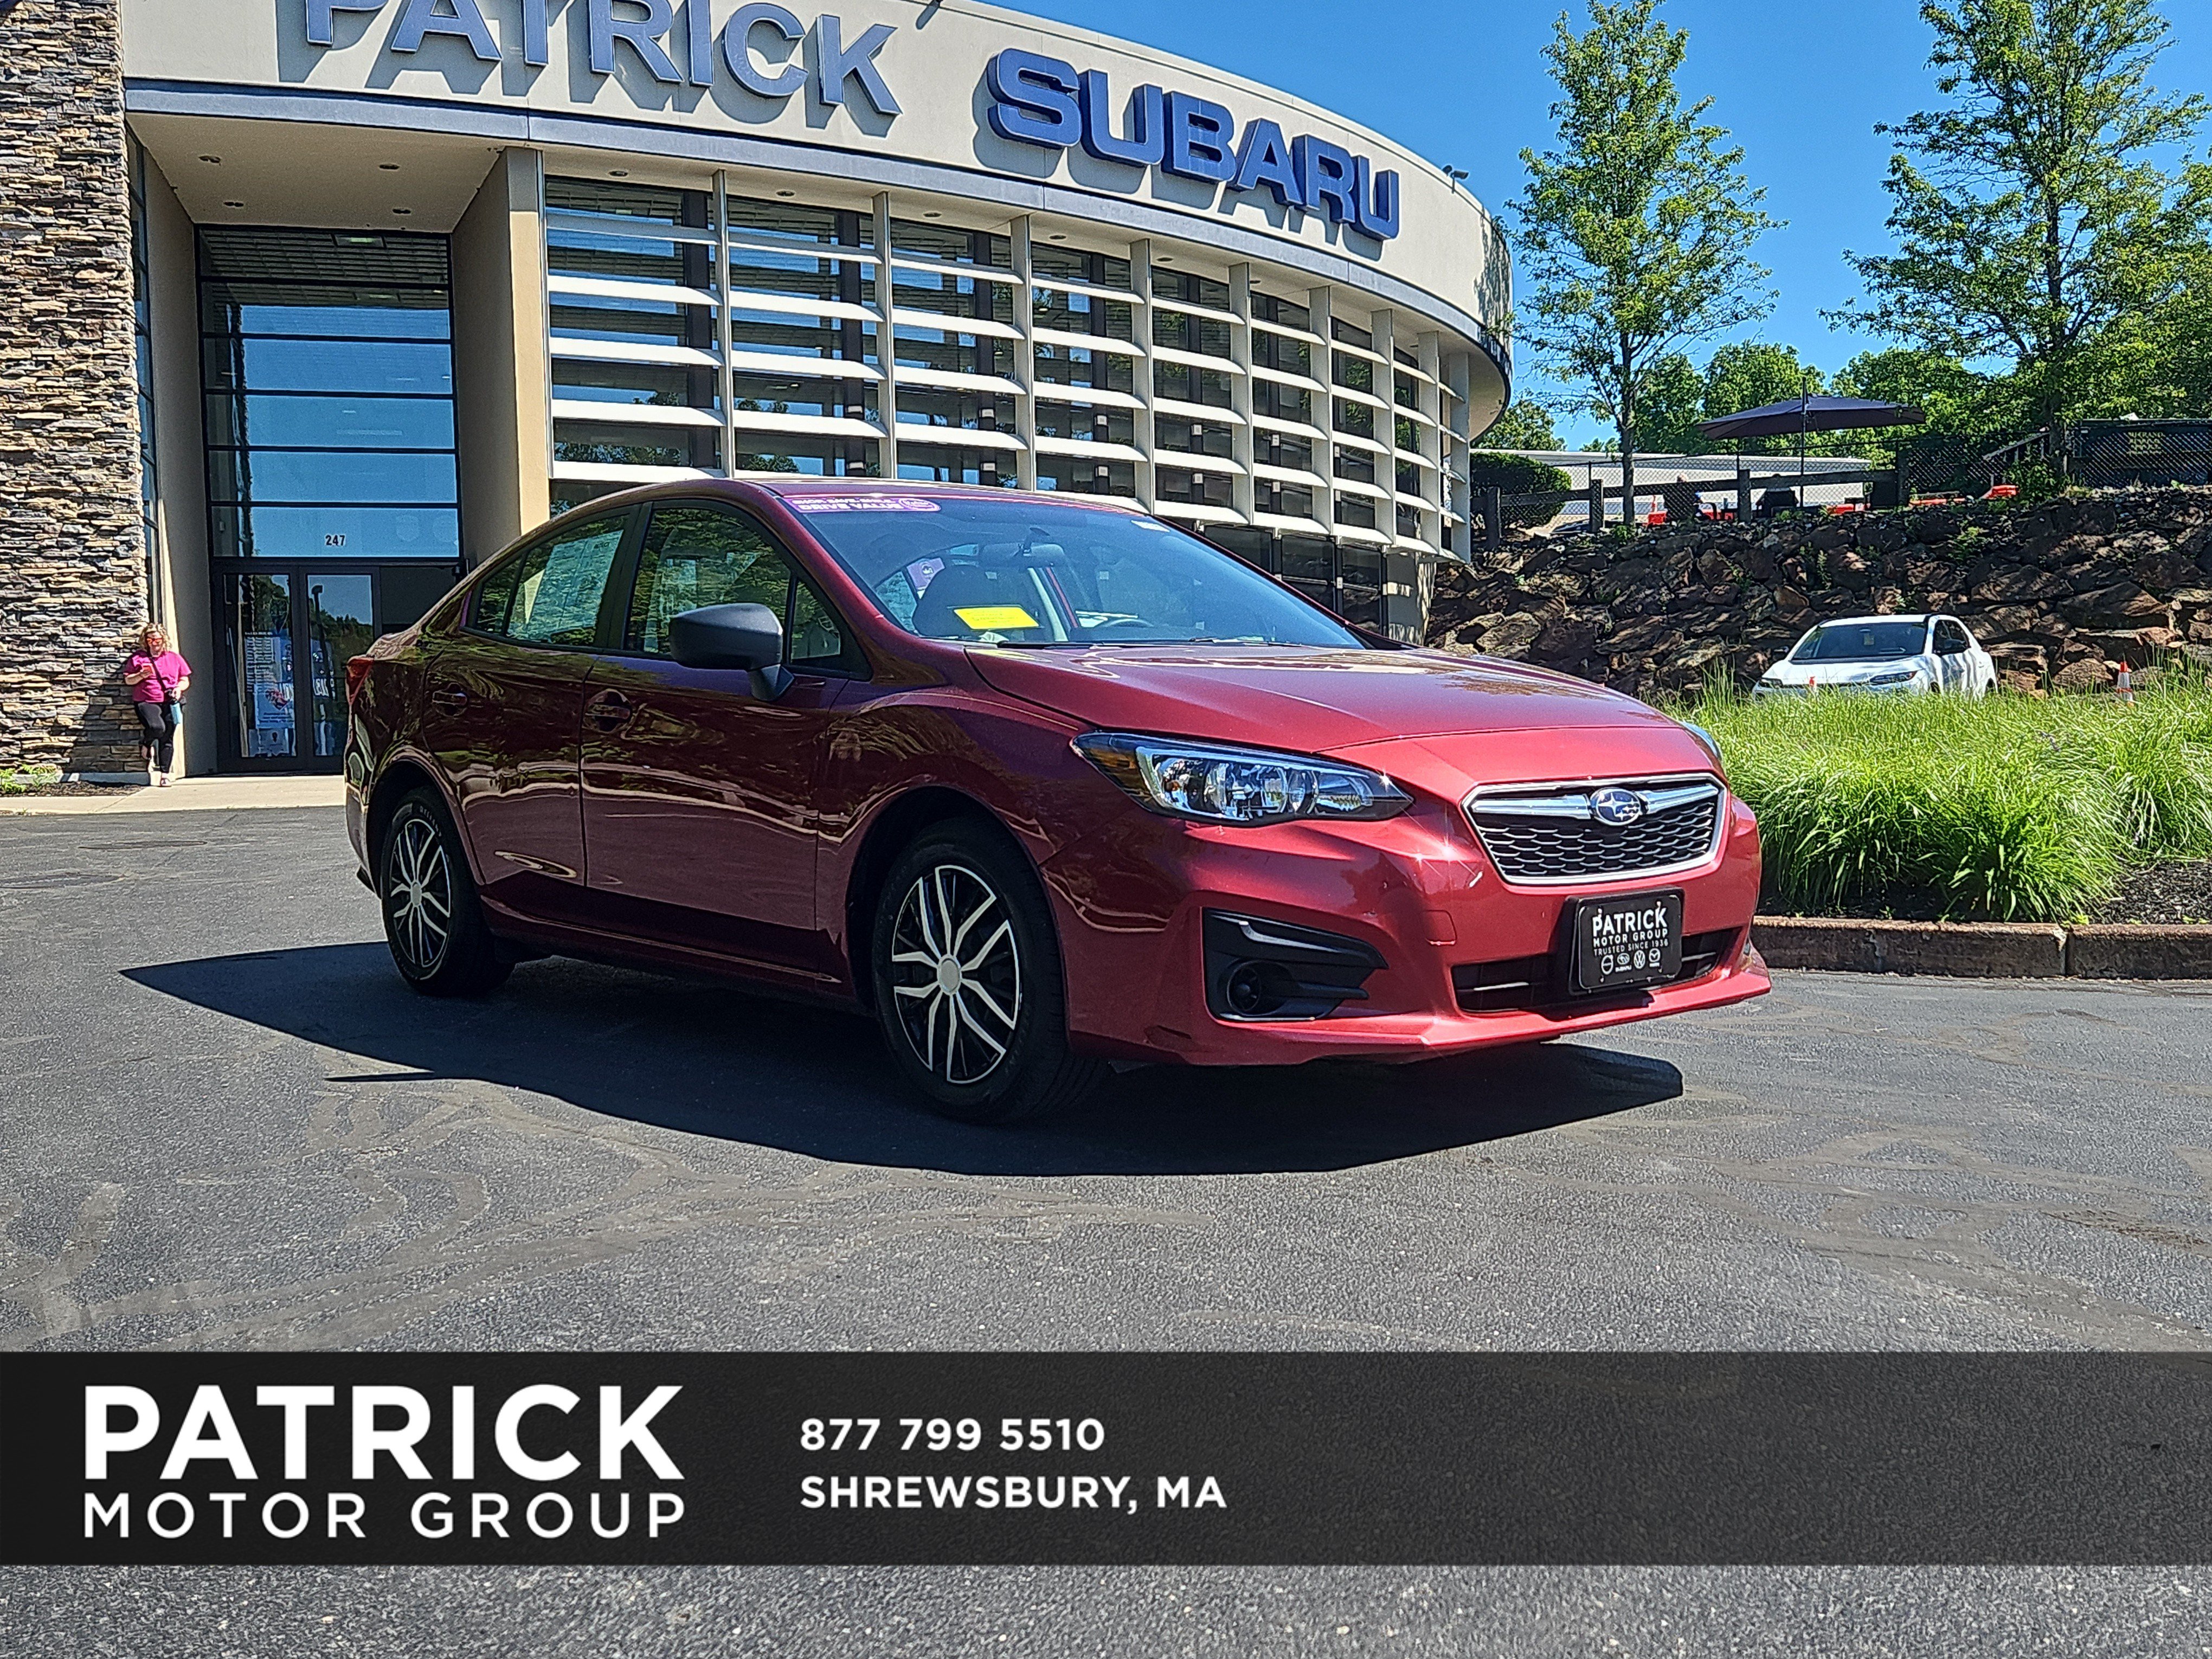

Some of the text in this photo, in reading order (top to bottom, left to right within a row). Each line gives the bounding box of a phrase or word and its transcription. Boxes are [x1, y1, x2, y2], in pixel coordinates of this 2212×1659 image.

[987, 48, 1400, 241] SUBARU
[325, 535, 345, 546] 247
[1592, 907, 1667, 937] PATRICK
[1593, 929, 1668, 948] MOTOR GROUP
[1593, 945, 1625, 956] TRUSTED
[1628, 941, 1649, 951] SINCE
